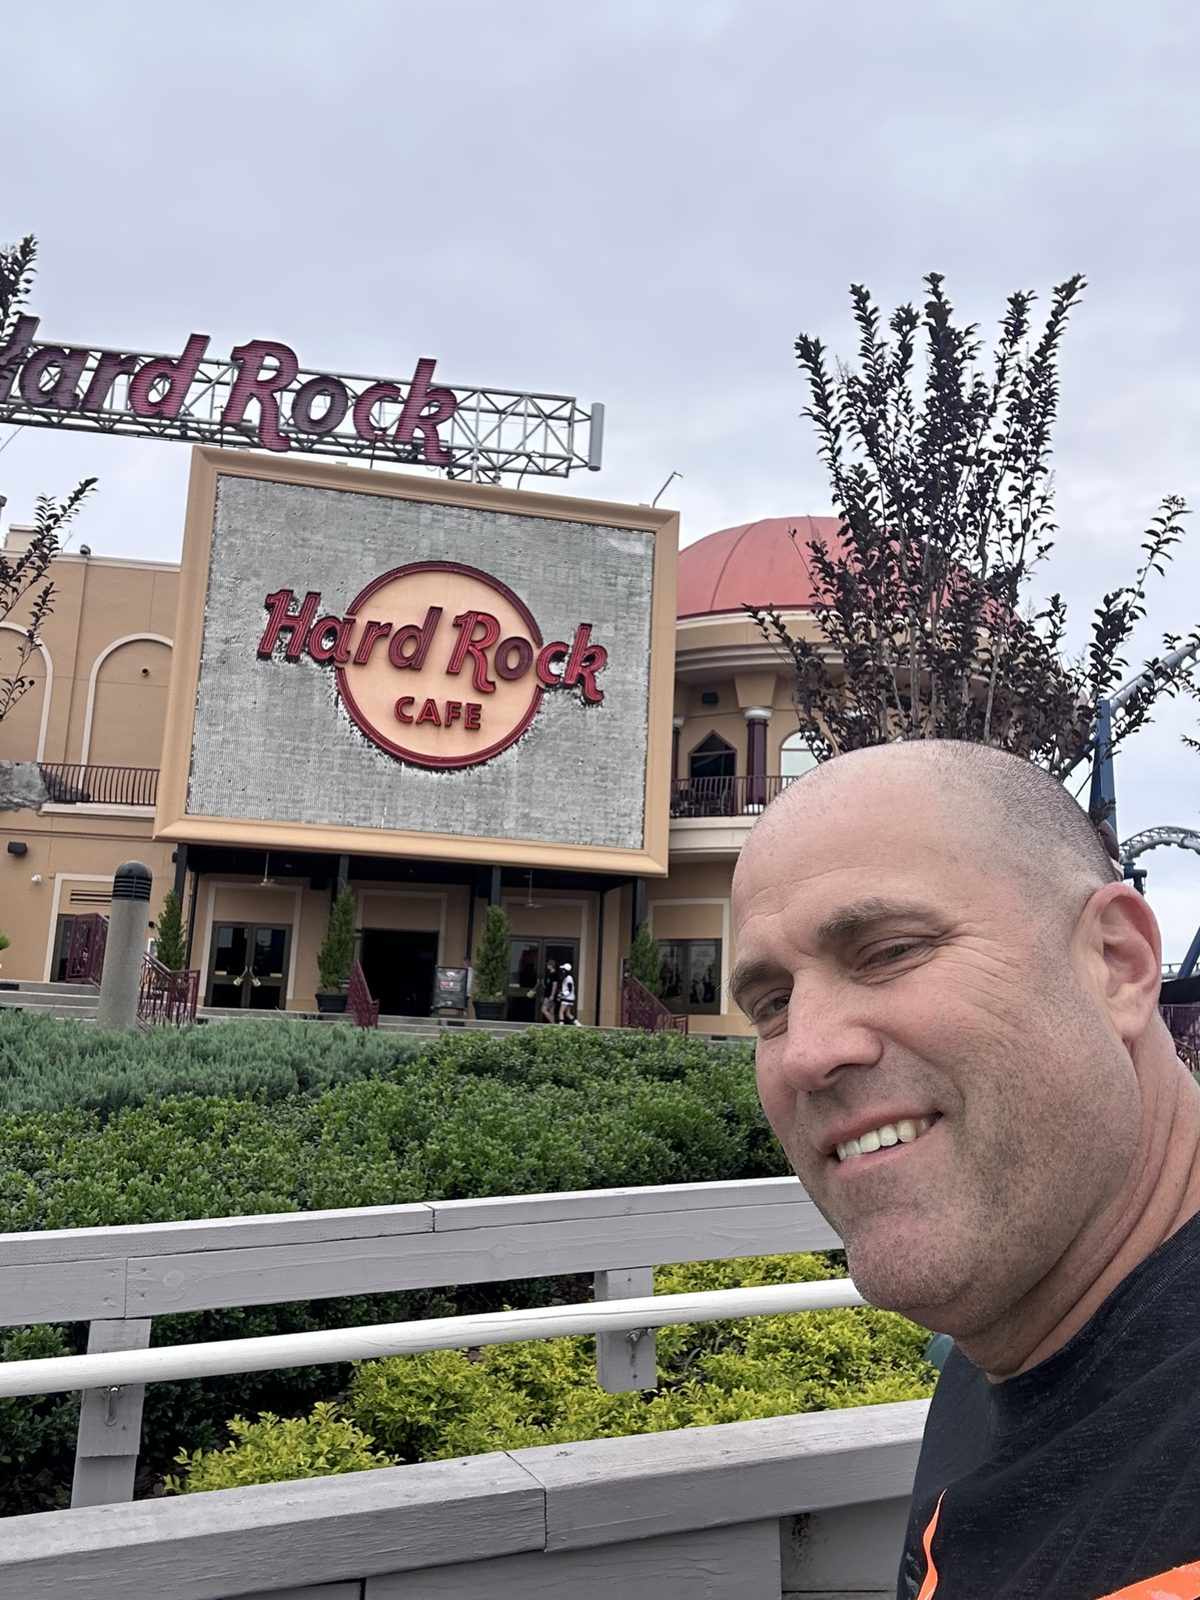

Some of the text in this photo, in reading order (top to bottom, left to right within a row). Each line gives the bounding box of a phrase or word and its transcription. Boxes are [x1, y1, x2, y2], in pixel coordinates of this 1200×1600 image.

[221, 339, 458, 467] Rock
[257, 588, 608, 704] Hard Rock
[394, 695, 482, 730] CAFE
